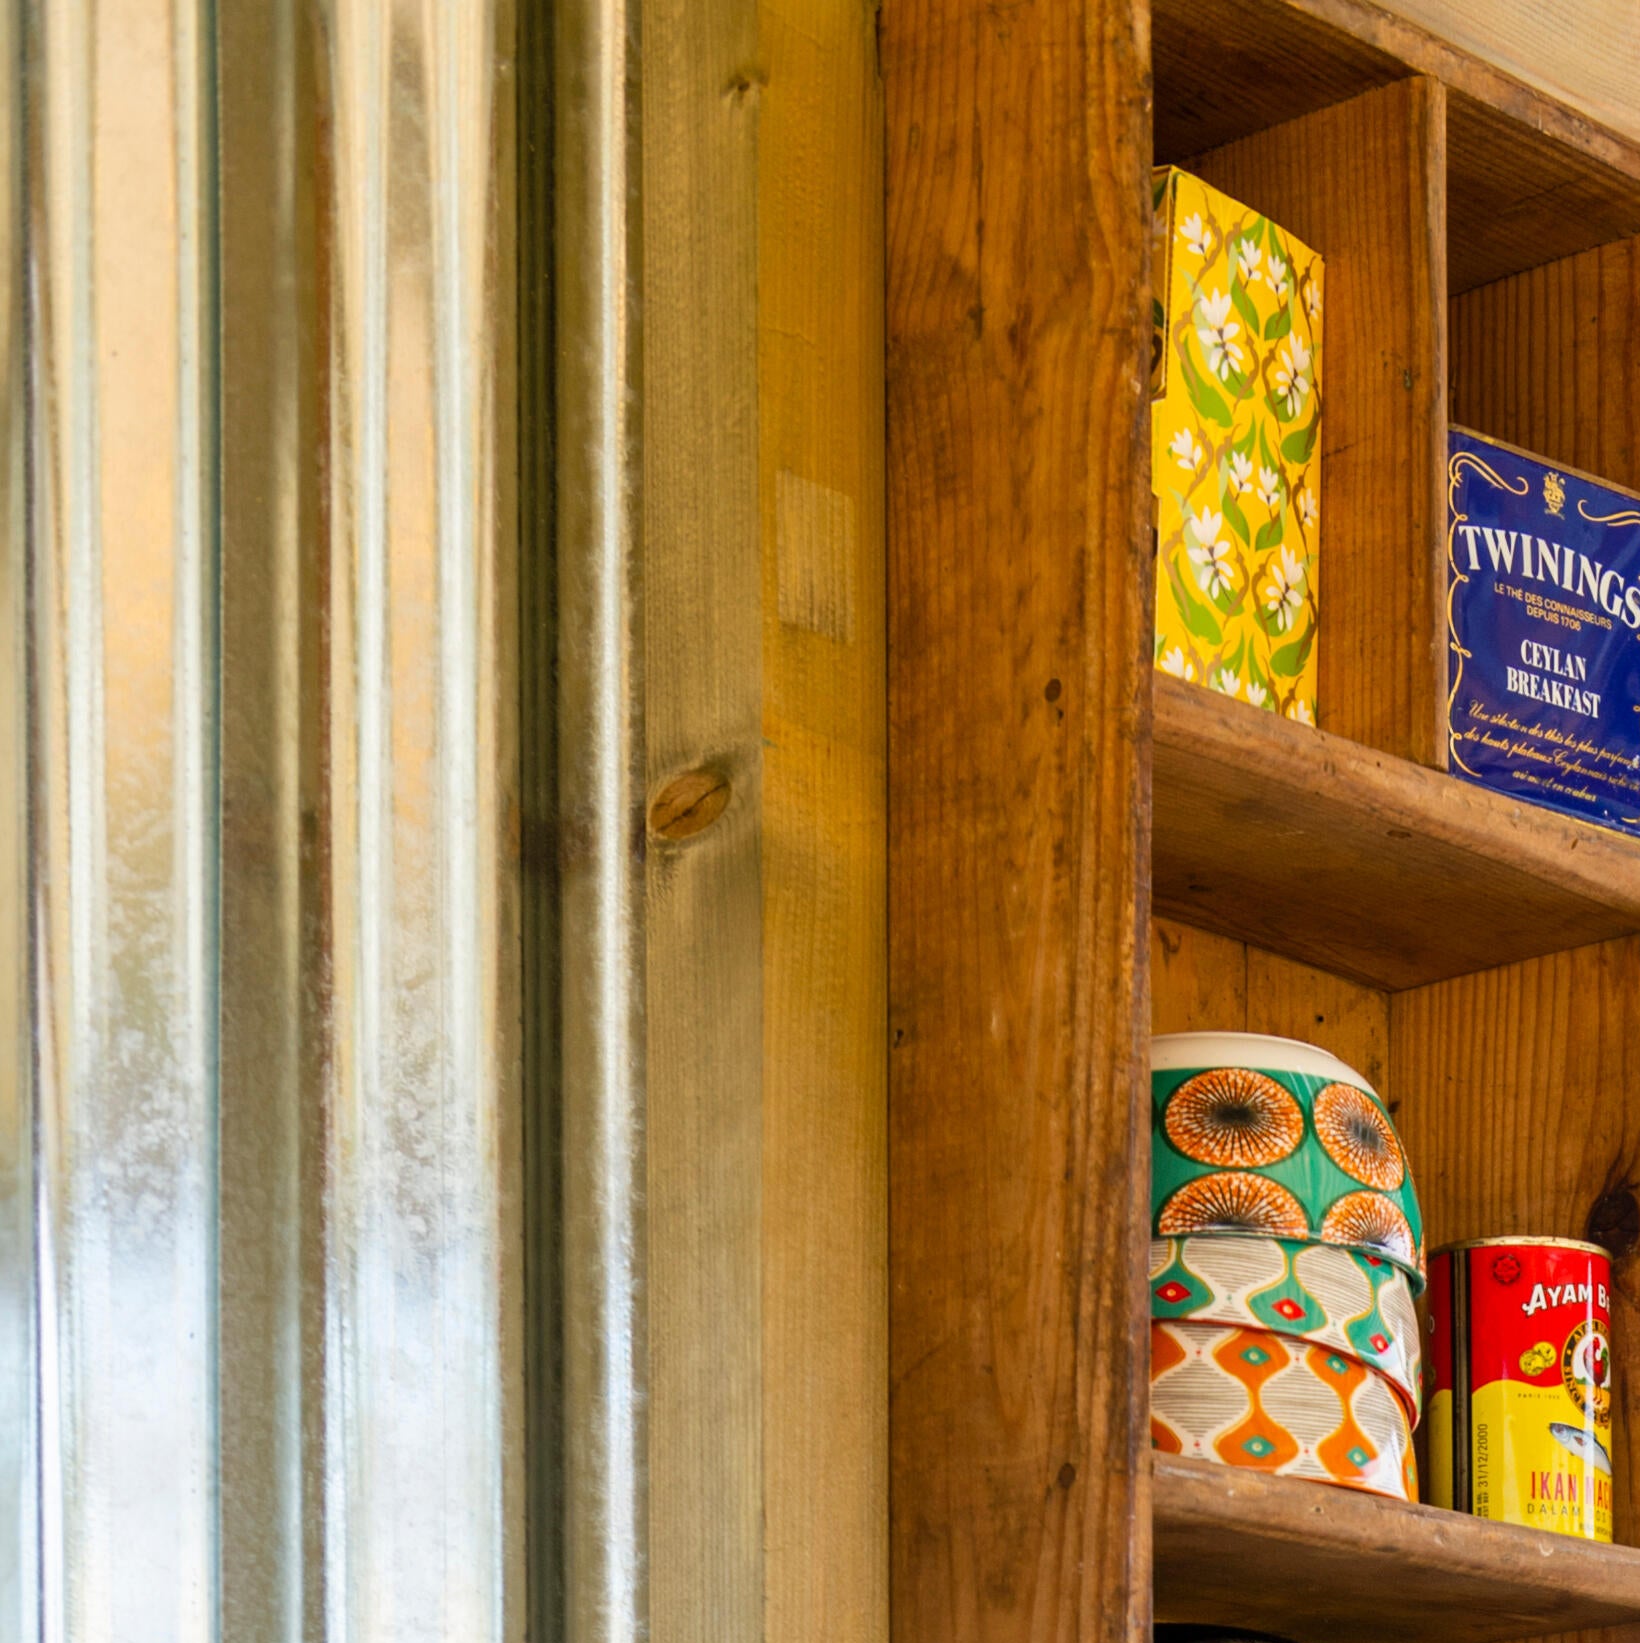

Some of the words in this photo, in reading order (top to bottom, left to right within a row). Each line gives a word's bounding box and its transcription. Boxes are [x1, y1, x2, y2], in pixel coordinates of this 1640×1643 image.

[1494, 582, 1505, 594] LE
[1506, 584, 1523, 601] THÉ
[1525, 592, 1543, 606] DES
[1544, 599, 1613, 630] CONNAISSEURS
[1527, 605, 1560, 624] DEPUIS
[1561, 616, 1581, 631] 1706
[1520, 639, 1587, 682] CEYLAN
[1506, 665, 1600, 719] BREAKFAST
[1522, 1284, 1593, 1316] AYAM
[1477, 1424, 1488, 1488] 31/12/2000
[1531, 1471, 1577, 1502] IKAN
[1527, 1503, 1580, 1517] DALAM
